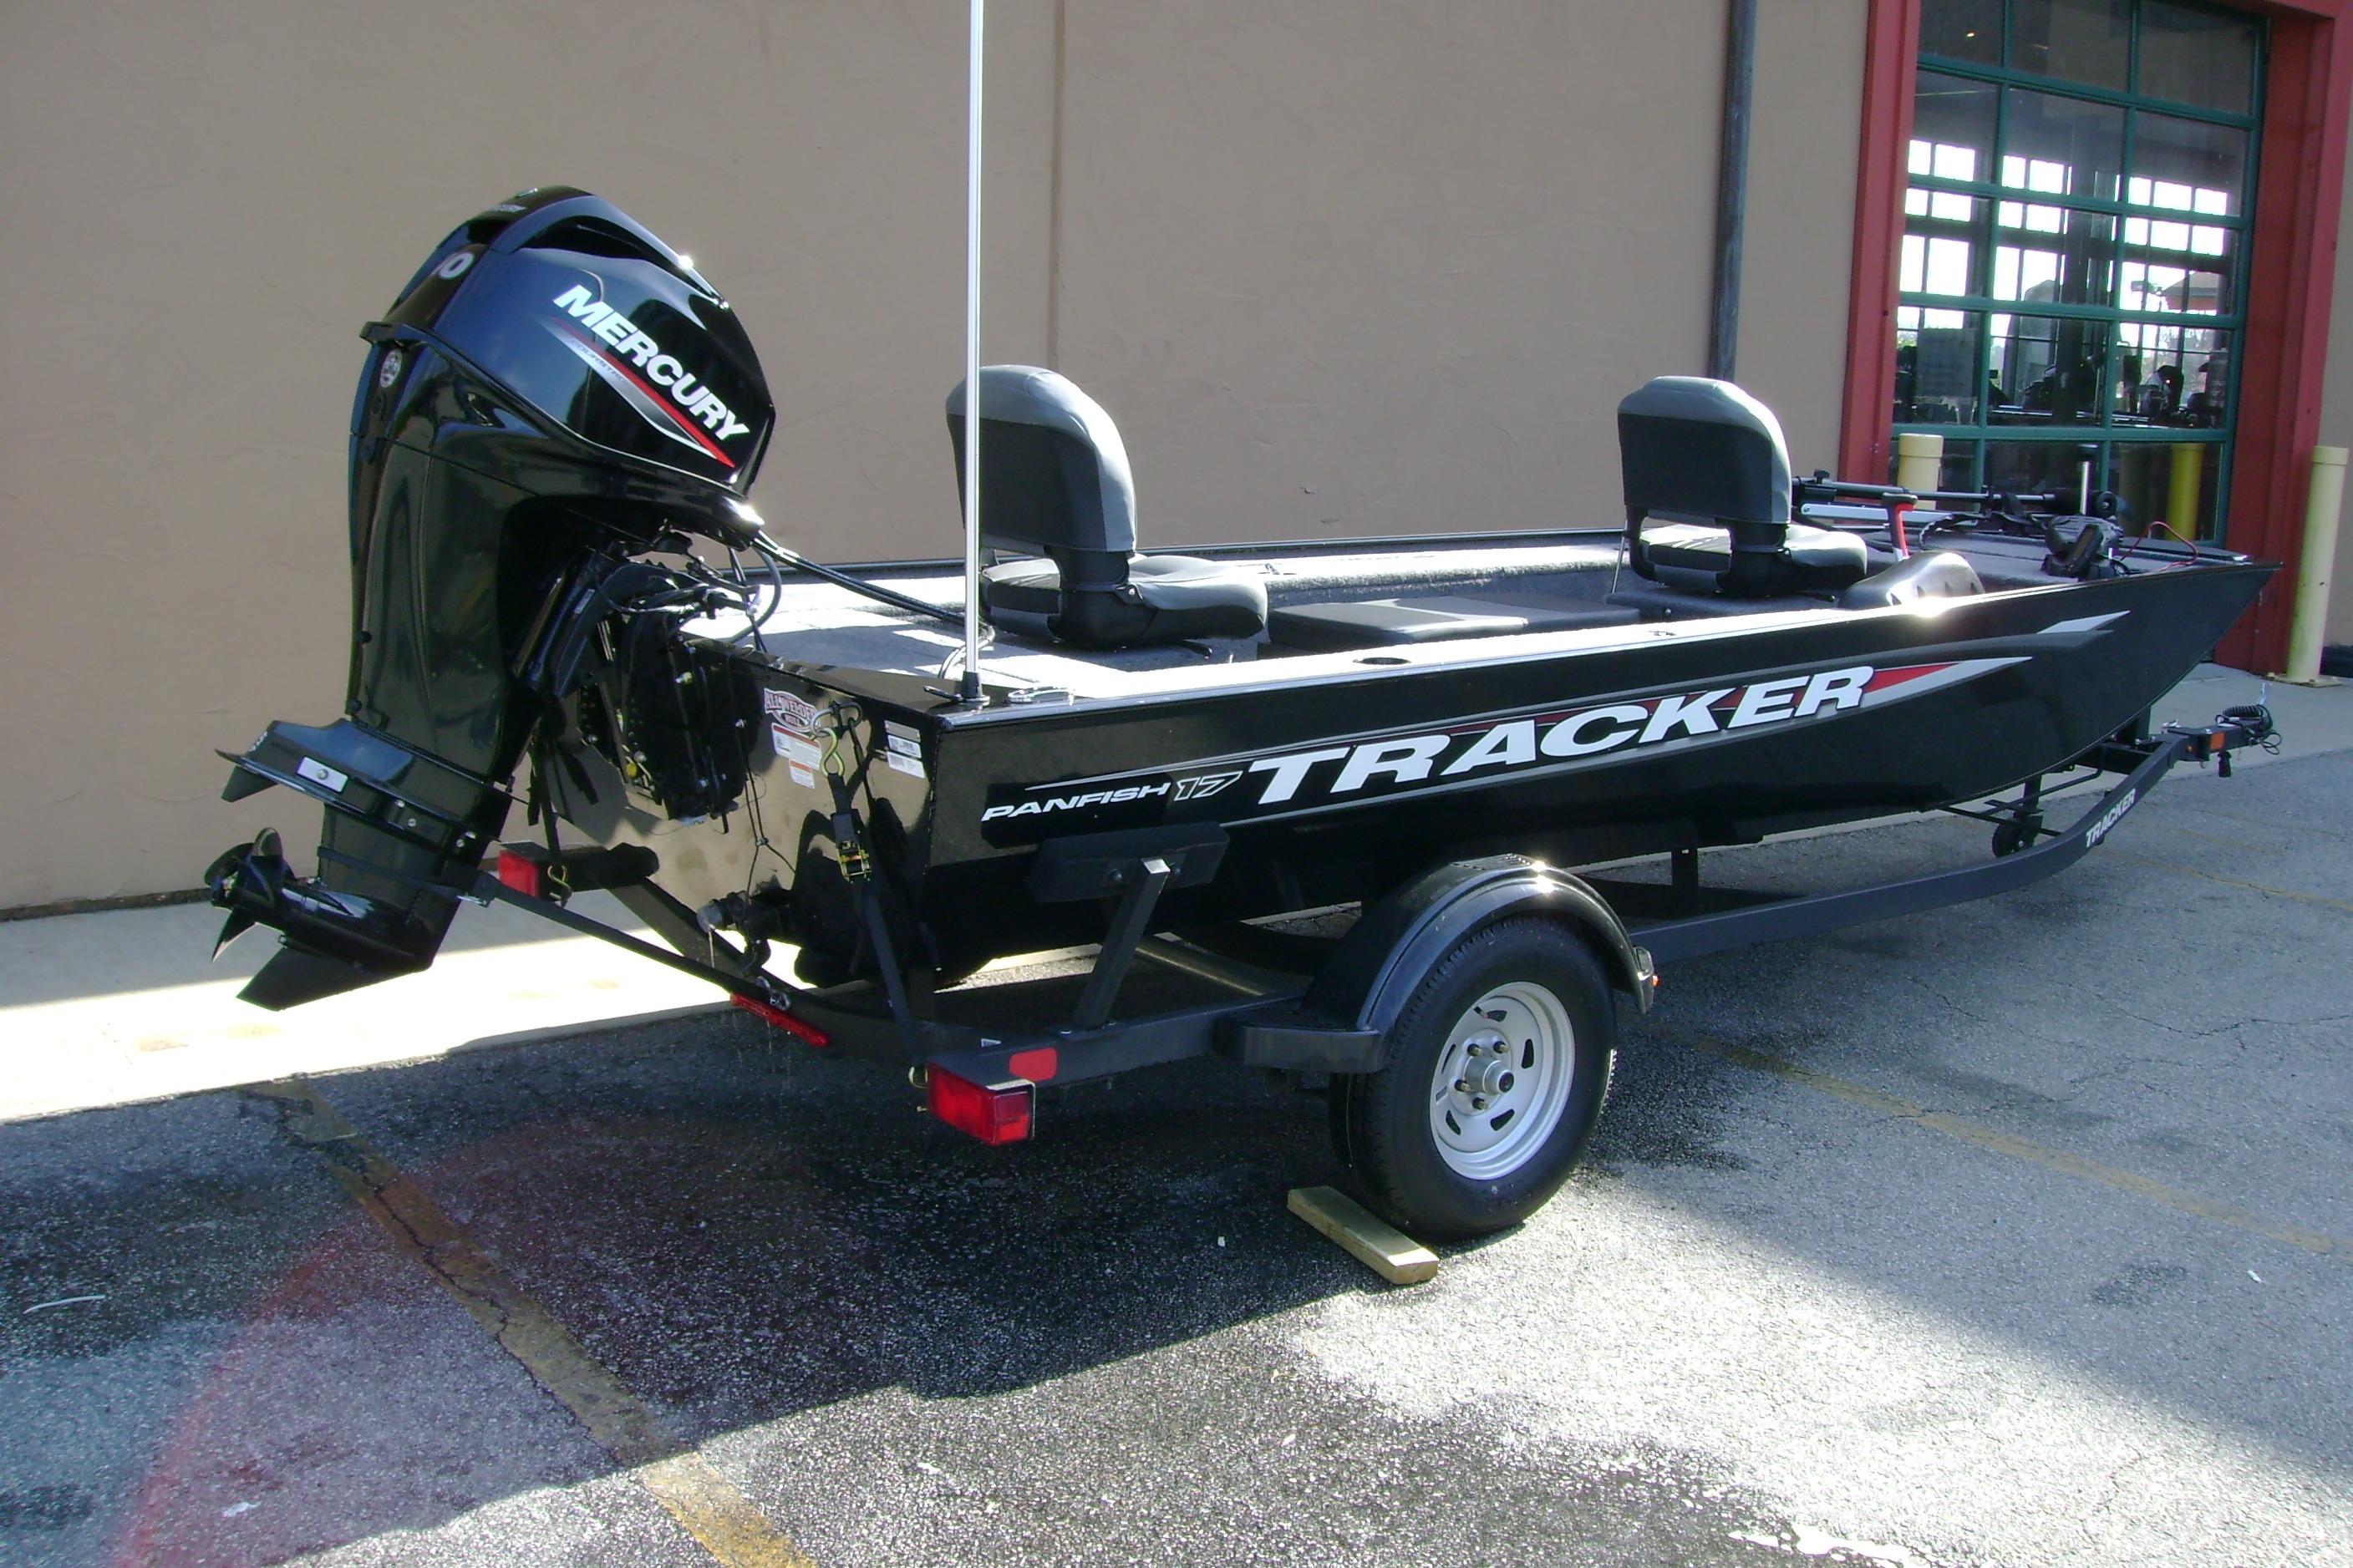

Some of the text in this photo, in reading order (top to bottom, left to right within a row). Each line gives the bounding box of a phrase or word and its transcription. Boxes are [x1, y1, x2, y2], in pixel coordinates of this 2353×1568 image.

[552, 284, 750, 440] MERCURY
[1248, 666, 1874, 804] TRACKER
[980, 770, 1243, 822] PANFISH 17
[2086, 788, 2136, 848] TRACKER
